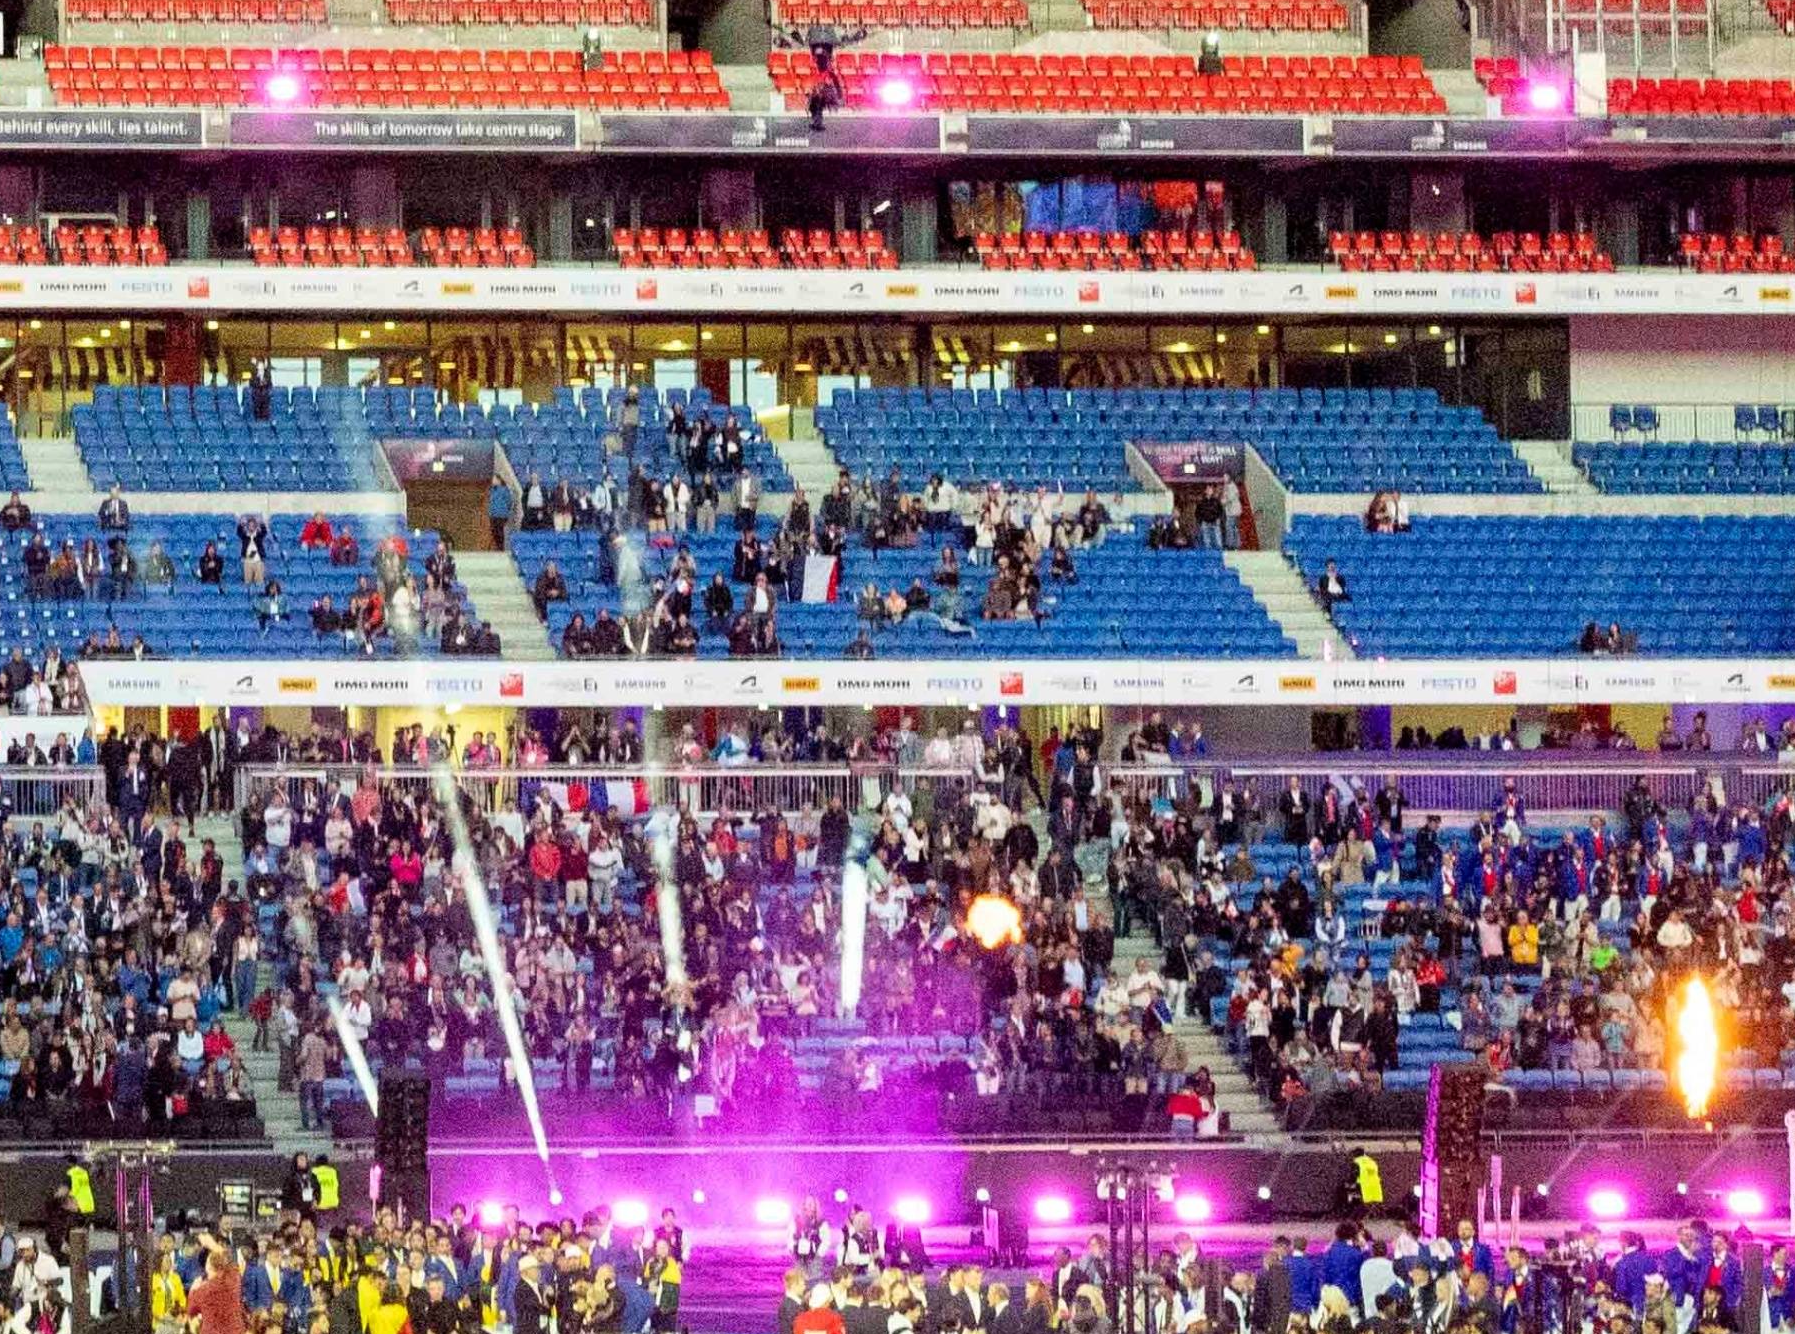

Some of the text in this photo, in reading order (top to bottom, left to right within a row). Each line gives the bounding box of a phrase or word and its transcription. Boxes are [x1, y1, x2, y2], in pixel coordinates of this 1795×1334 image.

[46, 123, 82, 138] every
[86, 120, 114, 135] skill,
[119, 121, 141, 134] lies
[145, 121, 188, 135] talent.
[315, 121, 565, 139] The skills of tomorrow take centre stage.
[334, 681, 408, 689] DMG MORI
[837, 680, 911, 688] DMG MORI
[1332, 680, 1405, 688] DMG MORI
